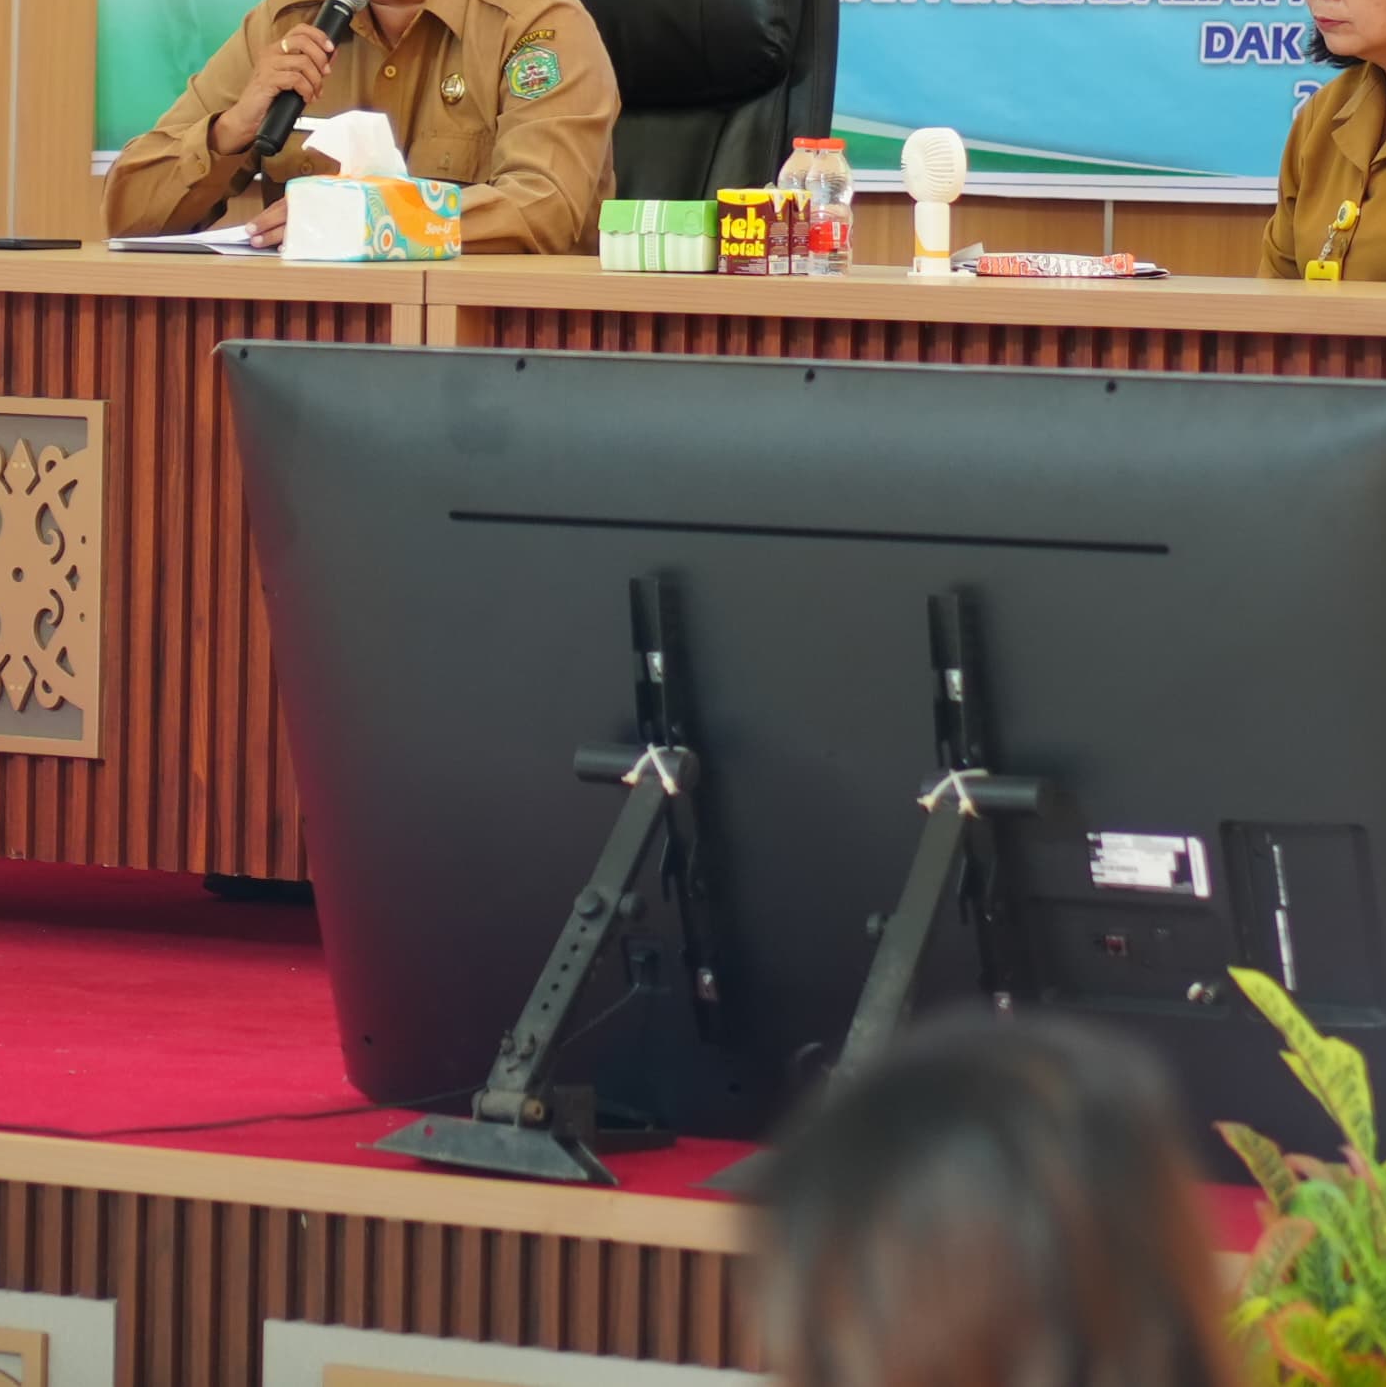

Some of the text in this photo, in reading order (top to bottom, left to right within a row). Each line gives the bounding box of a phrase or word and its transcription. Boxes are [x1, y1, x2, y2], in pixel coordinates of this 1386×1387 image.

[1204, 26, 1301, 60] DAK
[721, 207, 766, 240] teh
[721, 239, 766, 257] kotak
